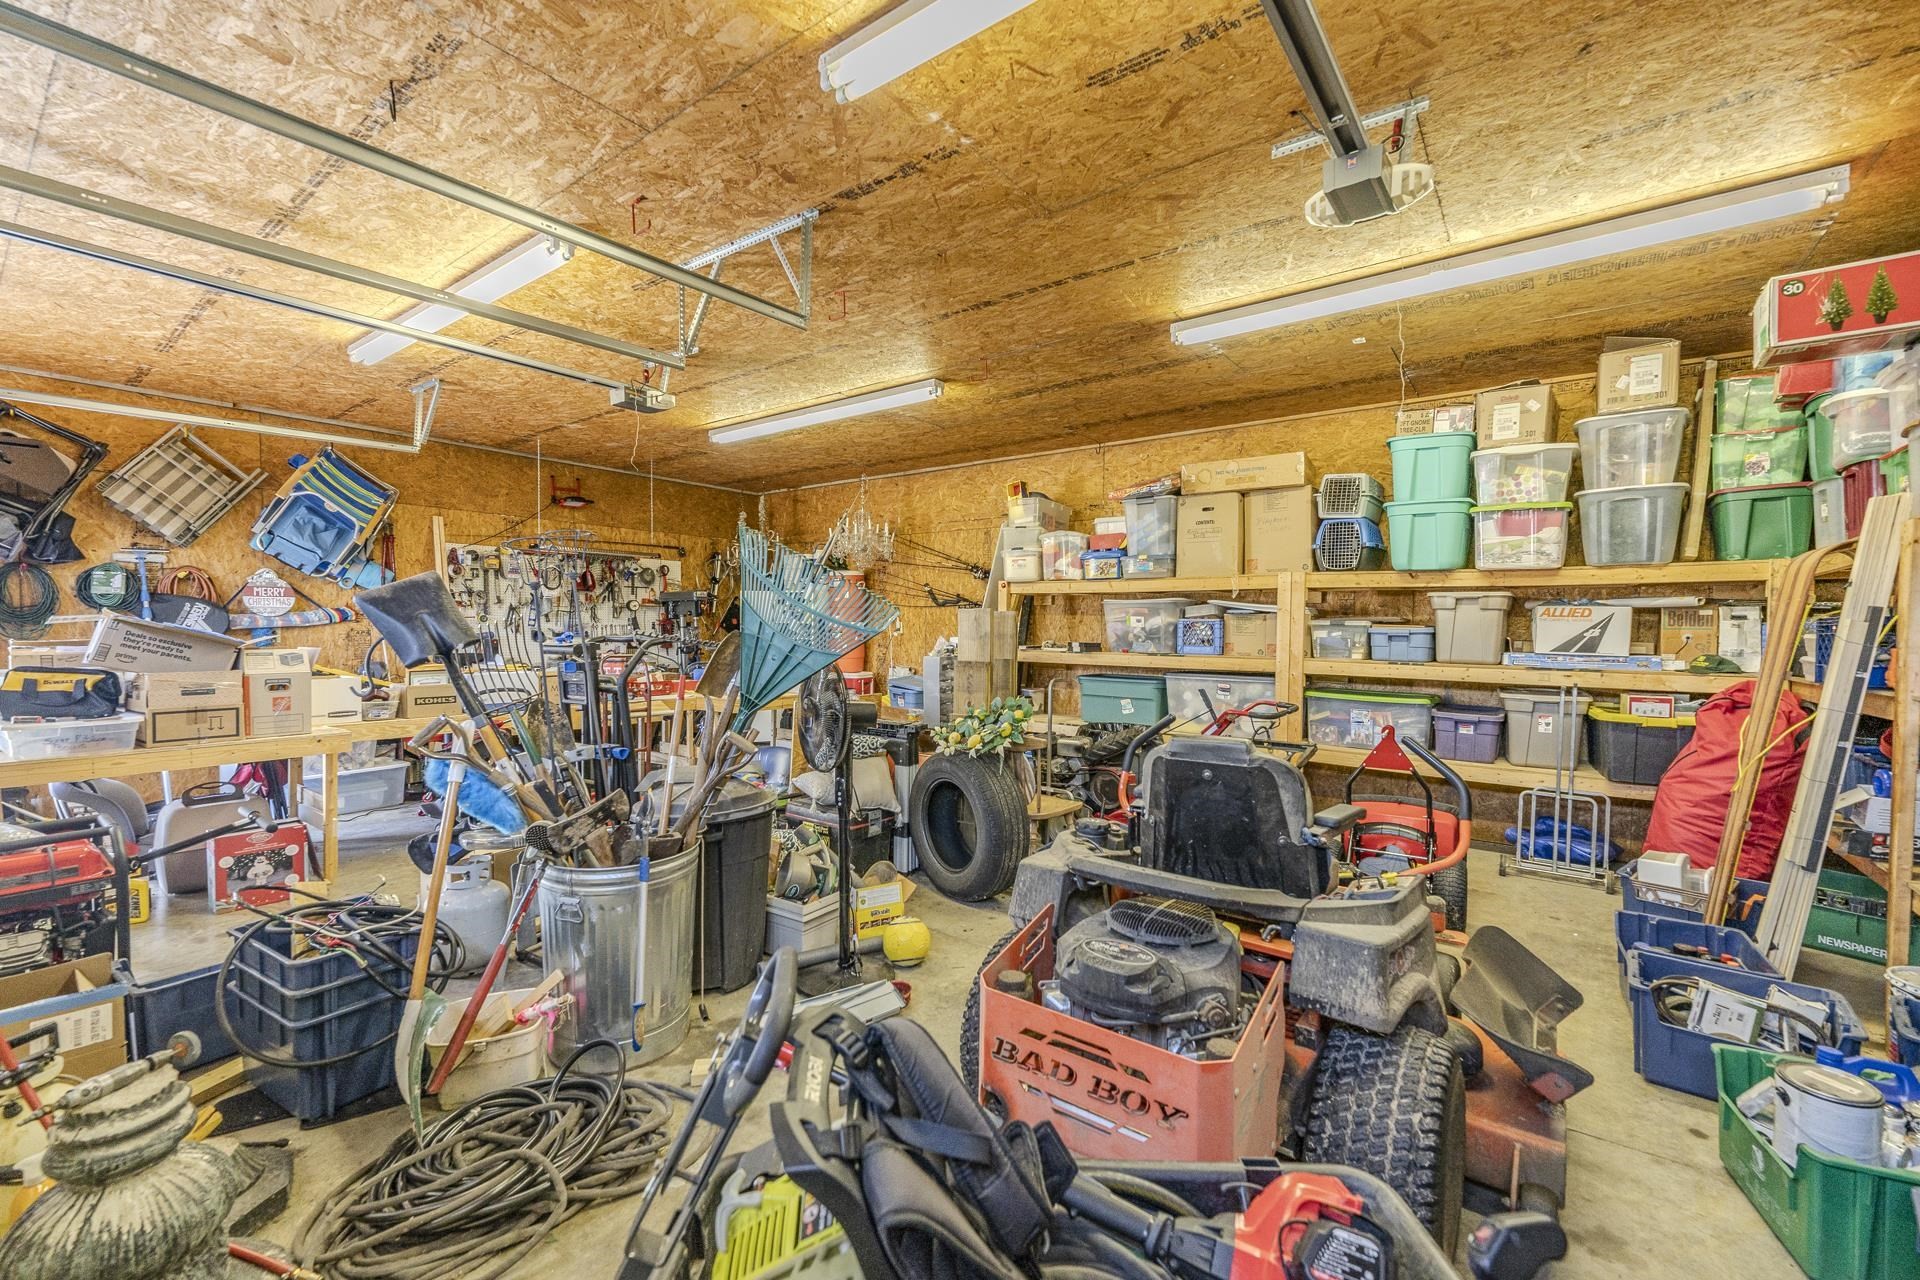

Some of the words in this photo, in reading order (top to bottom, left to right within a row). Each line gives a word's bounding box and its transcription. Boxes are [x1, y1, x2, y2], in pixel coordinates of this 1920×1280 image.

[1783, 283, 1804, 296] 30
[1525, 430, 1537, 438] 301
[252, 586, 286, 597] MERRY
[247, 597, 292, 607] CHRISTMAS
[1540, 607, 1593, 618] ALLIED
[1667, 609, 1713, 627] Belden
[123, 636, 151, 647] they're
[152, 642, 175, 653] ready
[125, 629, 147, 640] Deals
[158, 637, 193, 650] exclusive
[114, 652, 138, 661] prime
[120, 642, 141, 652] meet
[142, 647, 161, 656] your
[160, 650, 193, 662] parents.
[1817, 934, 1888, 960] NEWSPAPER
[991, 1036, 1077, 1087] BAD
[1087, 1074, 1190, 1132] BOY
